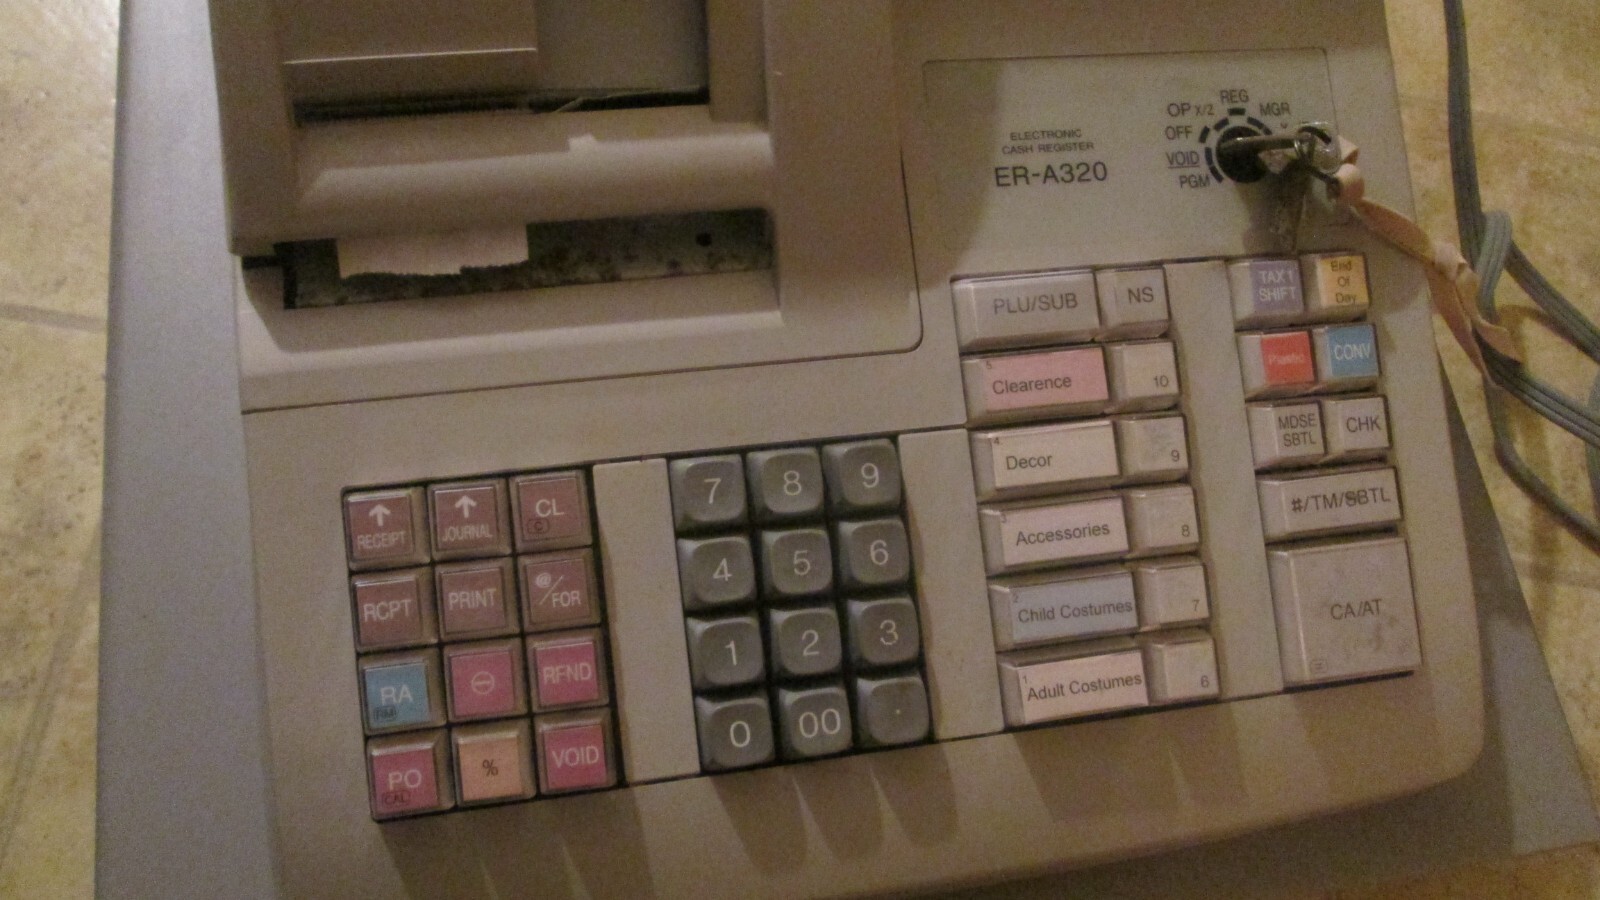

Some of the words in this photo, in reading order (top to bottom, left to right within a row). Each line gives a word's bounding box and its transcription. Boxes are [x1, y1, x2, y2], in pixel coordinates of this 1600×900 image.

[1220, 89, 1249, 105] REG
[1166, 103, 1191, 118] OP
[1259, 103, 1291, 117] MGR
[1009, 128, 1082, 141] ELECTRONIC
[1165, 125, 1193, 140] OFF
[1001, 143, 1034, 155] CASH
[1038, 141, 1095, 154] REGISTER
[1166, 151, 1200, 166] VOID
[994, 161, 1108, 187] ER-A320
[1179, 174, 1210, 189] PGM
[1331, 259, 1352, 272] End
[1259, 270, 1286, 283] TAX
[993, 292, 1078, 315] PLU/SUB
[1128, 287, 1154, 303] NS
[1258, 287, 1296, 302] SHIFT
[1335, 292, 1357, 305] Day
[1333, 343, 1371, 361] CONV
[992, 375, 1072, 395] Clearence
[1153, 375, 1169, 388] 10
[1278, 413, 1316, 430] MDSE
[1346, 416, 1381, 433] CHK
[1283, 431, 1317, 447] SBTL
[1006, 454, 1053, 471] Decor
[1170, 449, 1180, 462] 9
[783, 470, 802, 496] 8
[861, 462, 880, 489] 9
[704, 477, 722, 504] 7
[1291, 487, 1392, 512] #/TM/SBTL
[535, 499, 565, 518] CL
[442, 526, 492, 542] JOURNAL
[1015, 522, 1110, 546] Accessories
[1181, 524, 1190, 537] 8
[356, 531, 407, 549] RECEIPT
[869, 540, 889, 566] 6
[712, 557, 733, 582] 4
[793, 549, 811, 576] 5
[448, 588, 497, 610] PRINT
[1191, 599, 1200, 612] 7
[363, 599, 412, 622] RCPT
[1018, 606, 1055, 624] Child
[1060, 600, 1133, 620] Costumes
[1330, 599, 1382, 621] CA/AT
[879, 619, 899, 646] 3
[801, 629, 820, 656] 2
[725, 639, 737, 666] 1
[542, 662, 592, 685] RFND
[1200, 675, 1210, 688] 6
[380, 684, 414, 706] RA
[1027, 683, 1065, 702] Adult
[1069, 673, 1142, 695] Costumes
[799, 708, 841, 738] 00
[729, 720, 751, 748] 0
[551, 745, 600, 769] VOID
[482, 759, 498, 776] %
[388, 769, 422, 790] PO
